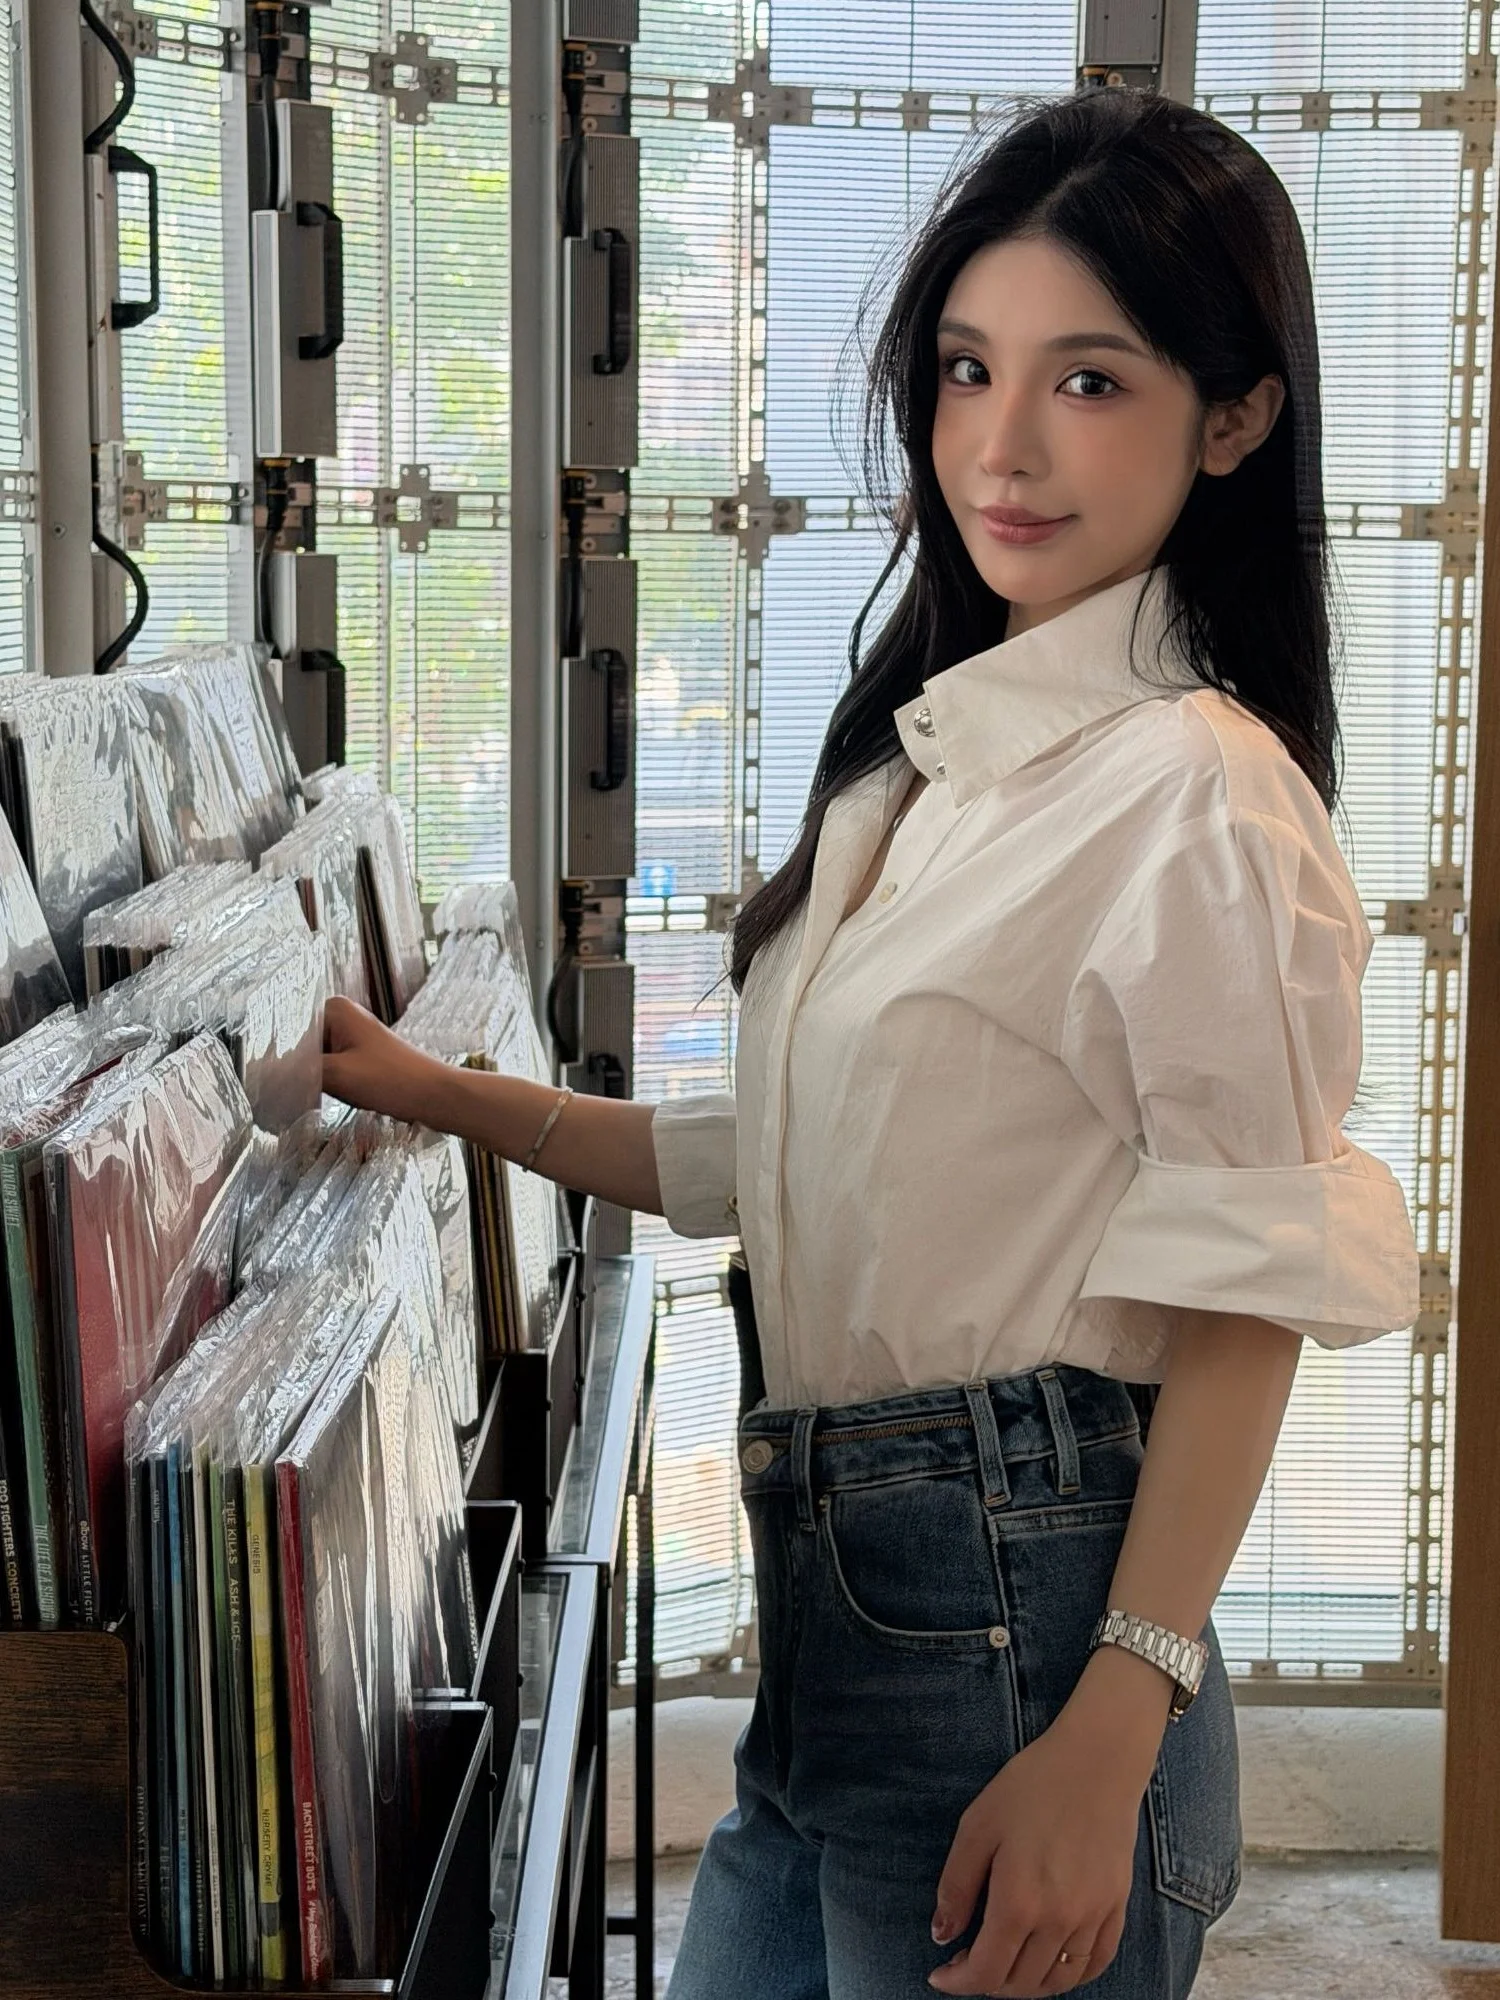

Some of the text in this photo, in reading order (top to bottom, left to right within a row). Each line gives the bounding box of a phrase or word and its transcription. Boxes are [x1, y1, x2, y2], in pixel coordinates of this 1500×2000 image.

[1, 1163, 20, 1229] TAYLOR SWIFT
[0, 1480, 9, 1503] FOO
[1, 1504, 15, 1557] FIGHTERS
[35, 1523, 48, 1540] THE
[80, 1520, 90, 1550] elbow
[37, 1543, 51, 1562] LIFE
[251, 1534, 261, 1574] GENESIS
[38, 1563, 53, 1576] OF
[82, 1555, 92, 1586] LITTLE
[226, 1499, 241, 1642] THE KILLS ASH & ICE
[302, 1801, 315, 1863] BACKSTREET
